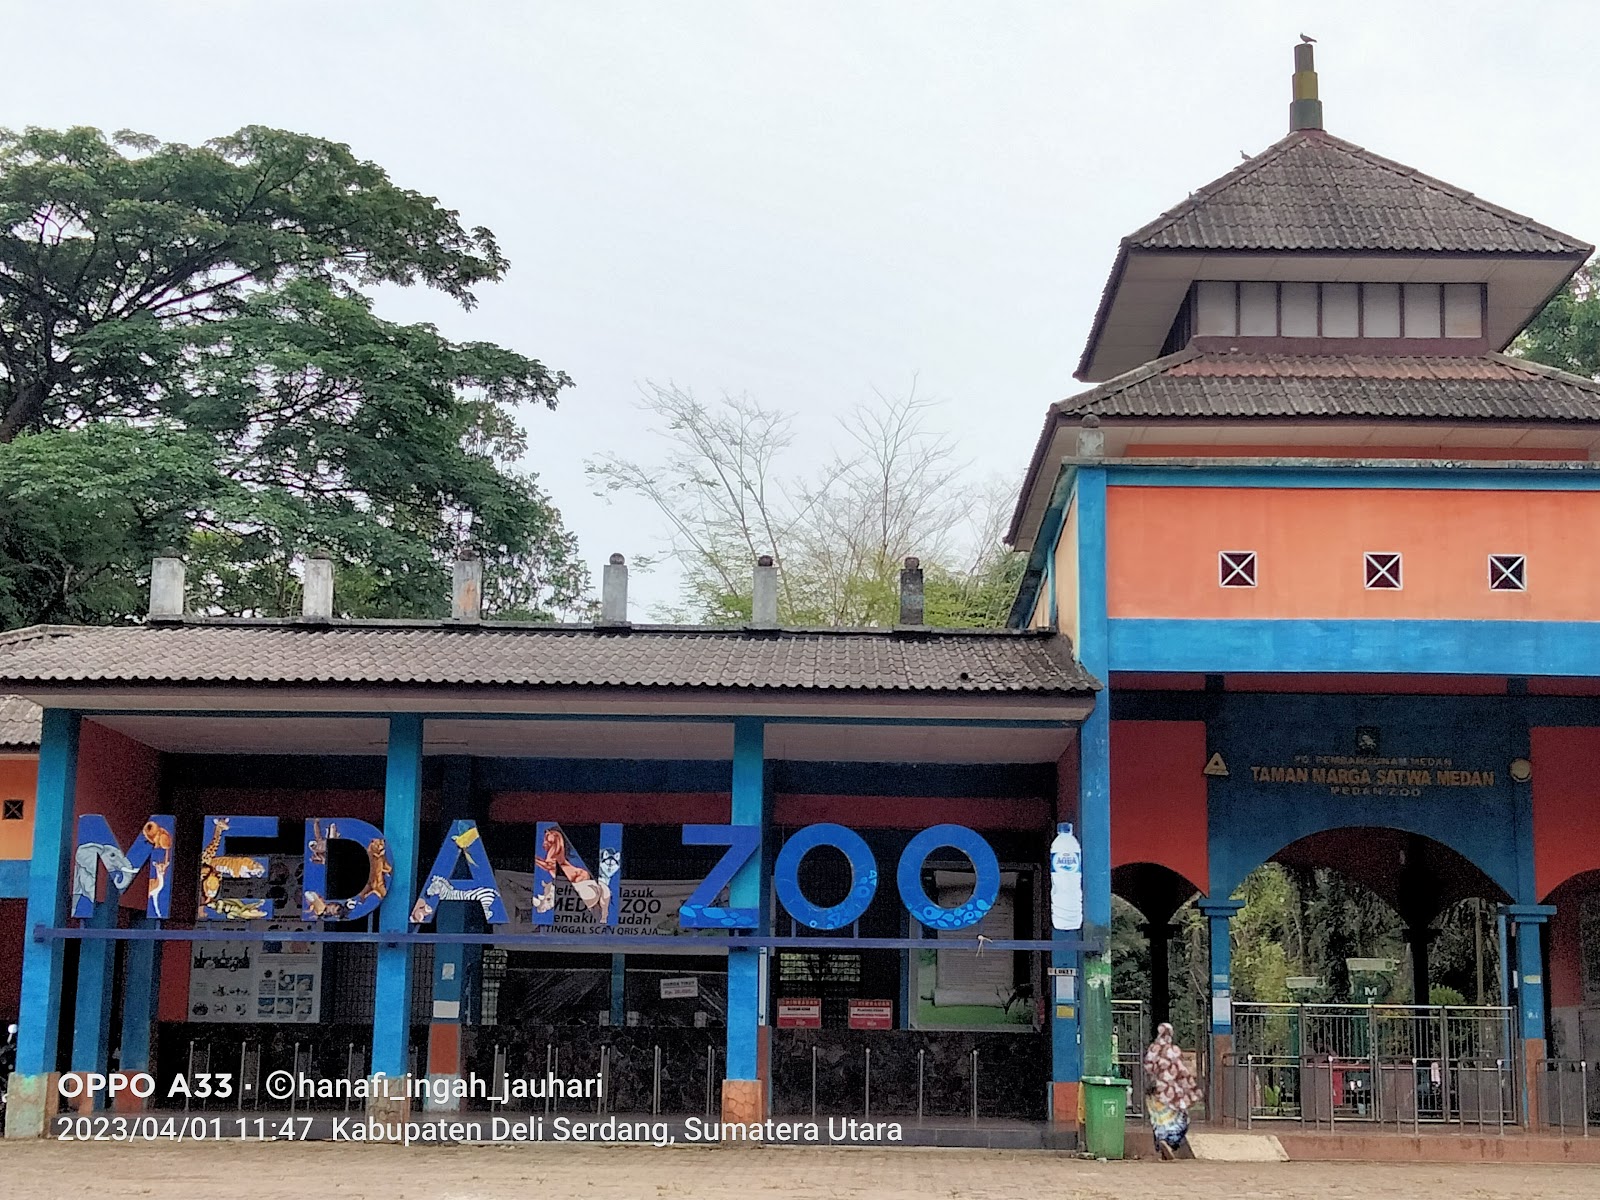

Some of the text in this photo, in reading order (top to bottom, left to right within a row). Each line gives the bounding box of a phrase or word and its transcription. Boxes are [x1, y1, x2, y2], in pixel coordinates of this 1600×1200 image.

[1251, 766, 1495, 786] TAMAN MARGA SATWA MEDAN
[1330, 786, 1421, 797] MEDAN ZOO
[1056, 856, 1077, 866] AQUA
[69, 814, 1000, 931] MEDAN ZOO
[554, 884, 573, 896] eli
[620, 898, 662, 914] ZOO
[618, 913, 652, 925] udah
[546, 925, 586, 935] TINGGAL
[589, 926, 614, 935] SCAN
[617, 927, 639, 937] QRIS
